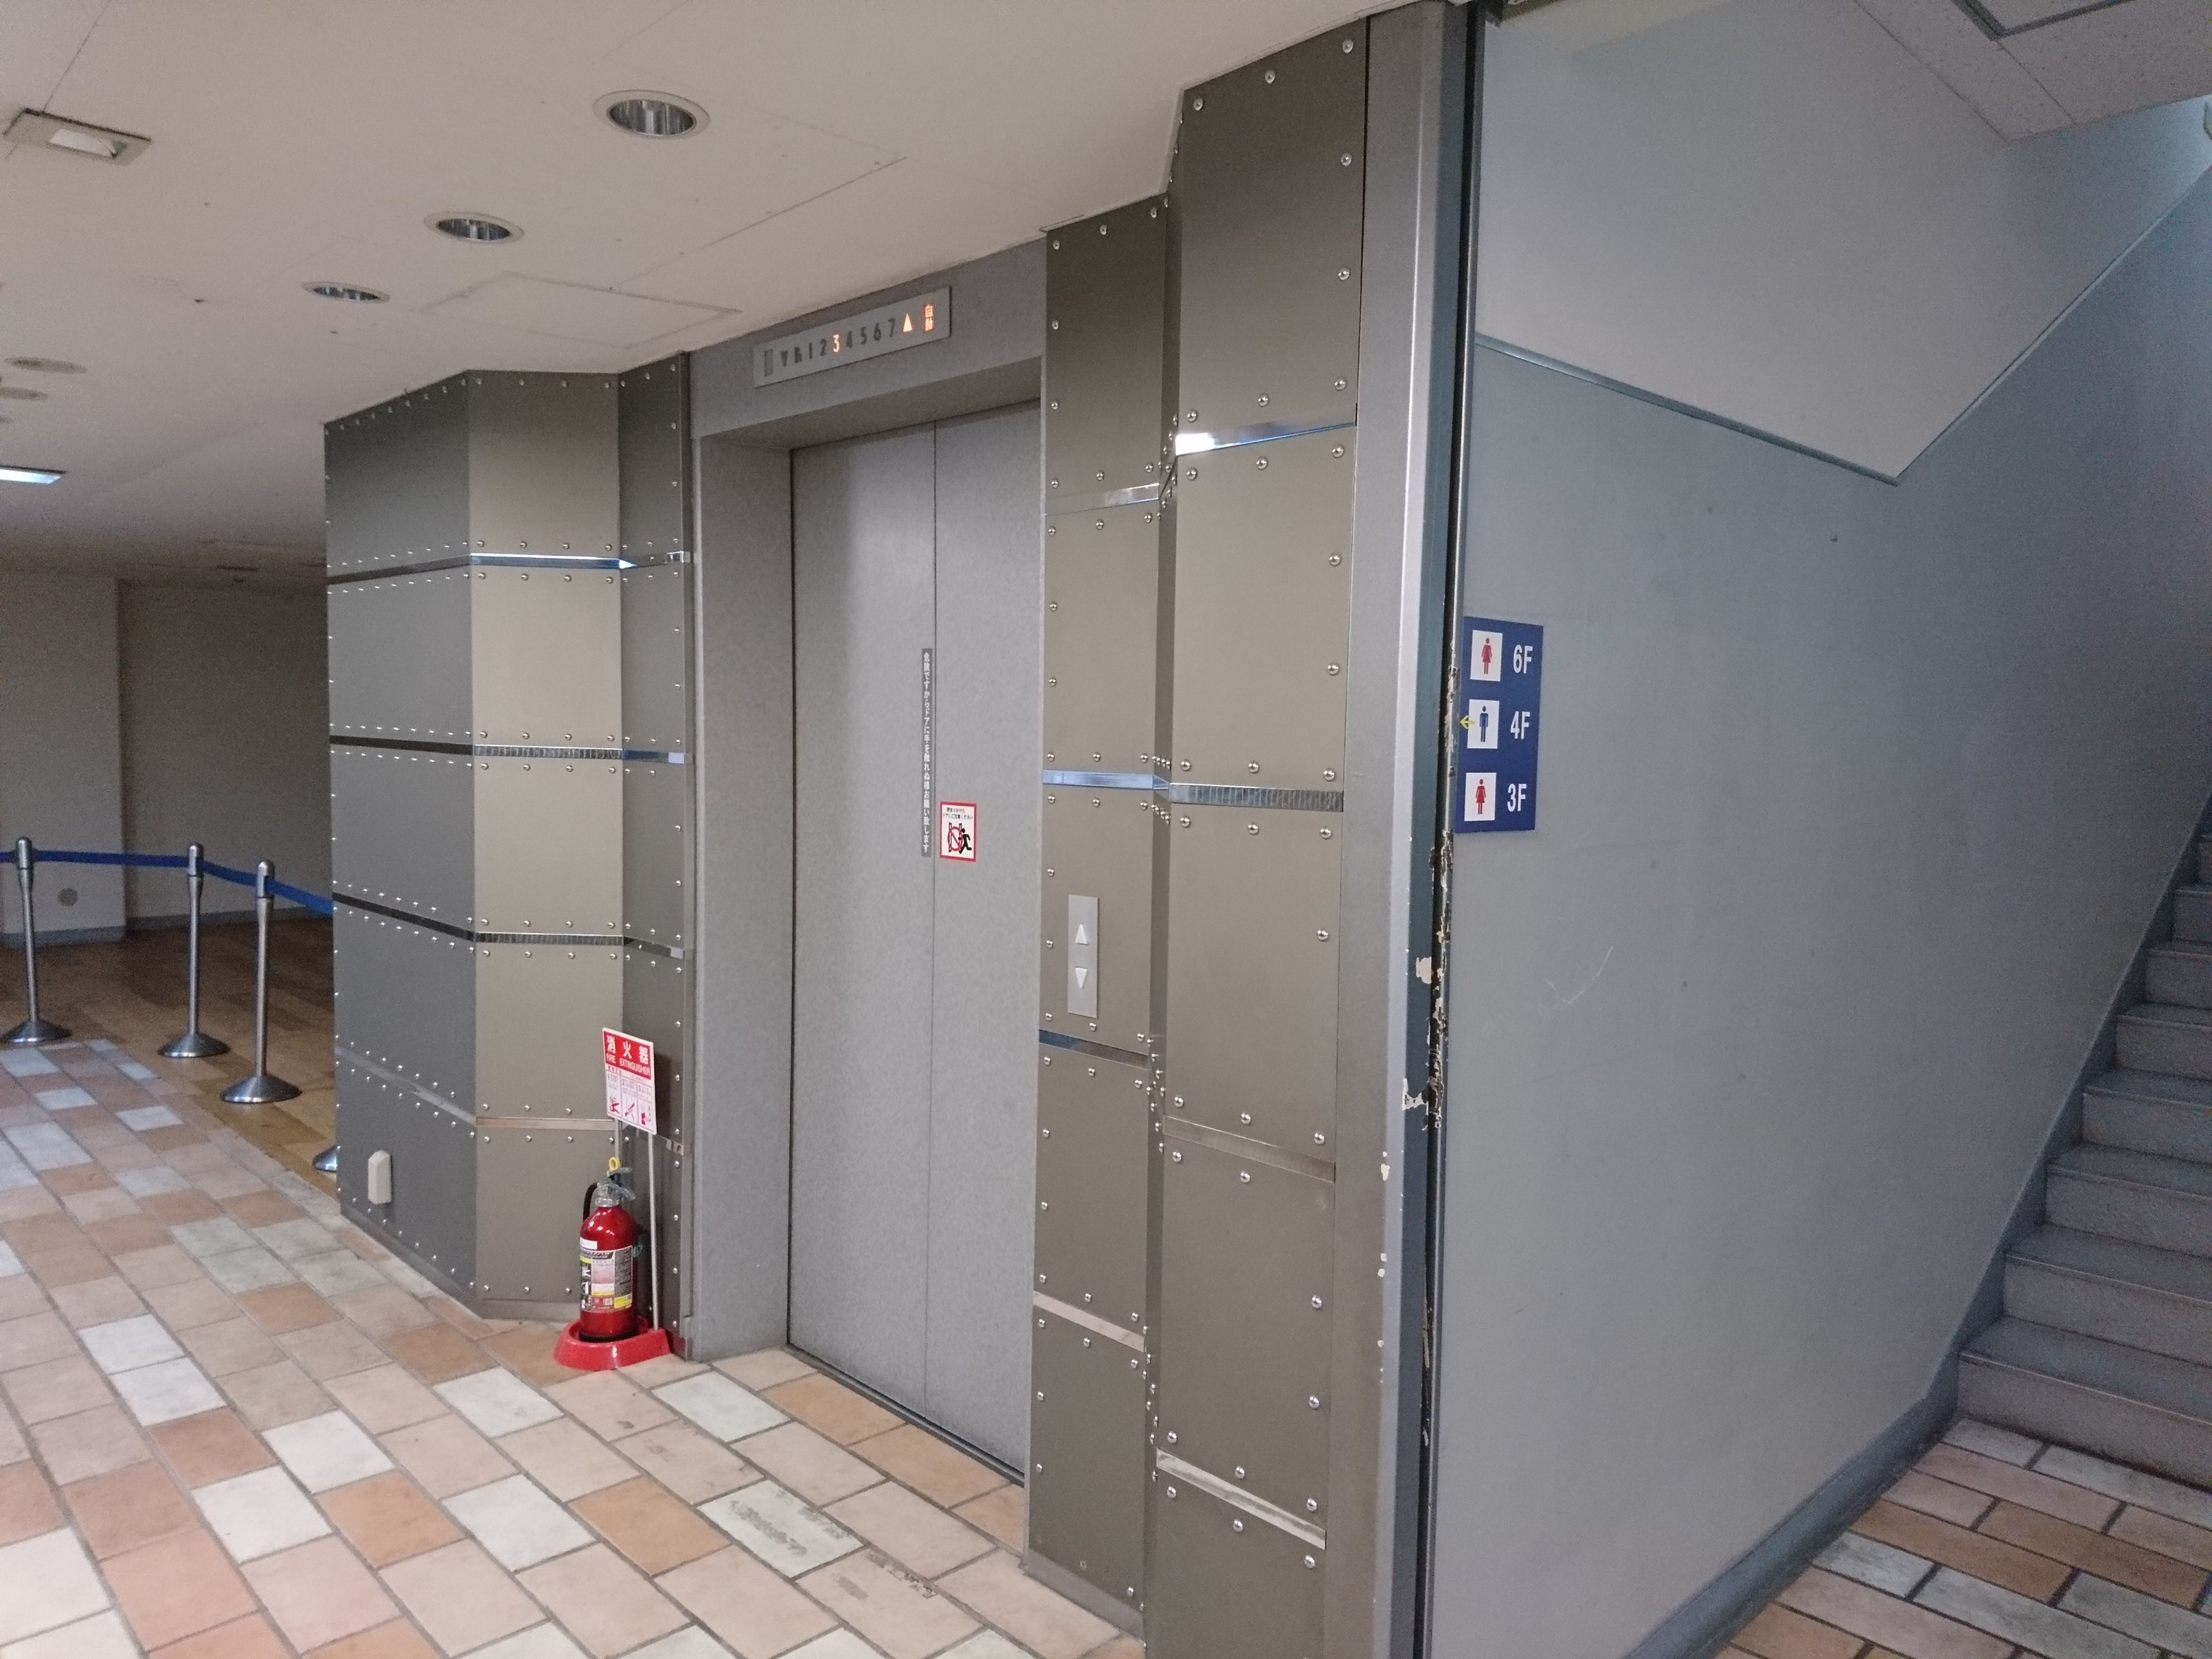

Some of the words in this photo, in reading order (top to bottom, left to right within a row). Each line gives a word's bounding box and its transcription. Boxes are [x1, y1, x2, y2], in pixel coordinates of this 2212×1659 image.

[809, 342, 813, 359] 1
[820, 339, 827, 356] 2
[833, 333, 840, 353] 3
[846, 331, 853, 349] 4
[860, 326, 868, 345] 5
[873, 323, 881, 341] 6
[888, 317, 896, 337] 7
[925, 304, 933, 331] 自動
[1513, 644, 1533, 674] 6F
[1510, 711, 1530, 739] 4F
[1507, 783, 1527, 812] 3F
[607, 1034, 649, 1065] 消火器
[620, 1058, 651, 1076] EXTINGUISHER
